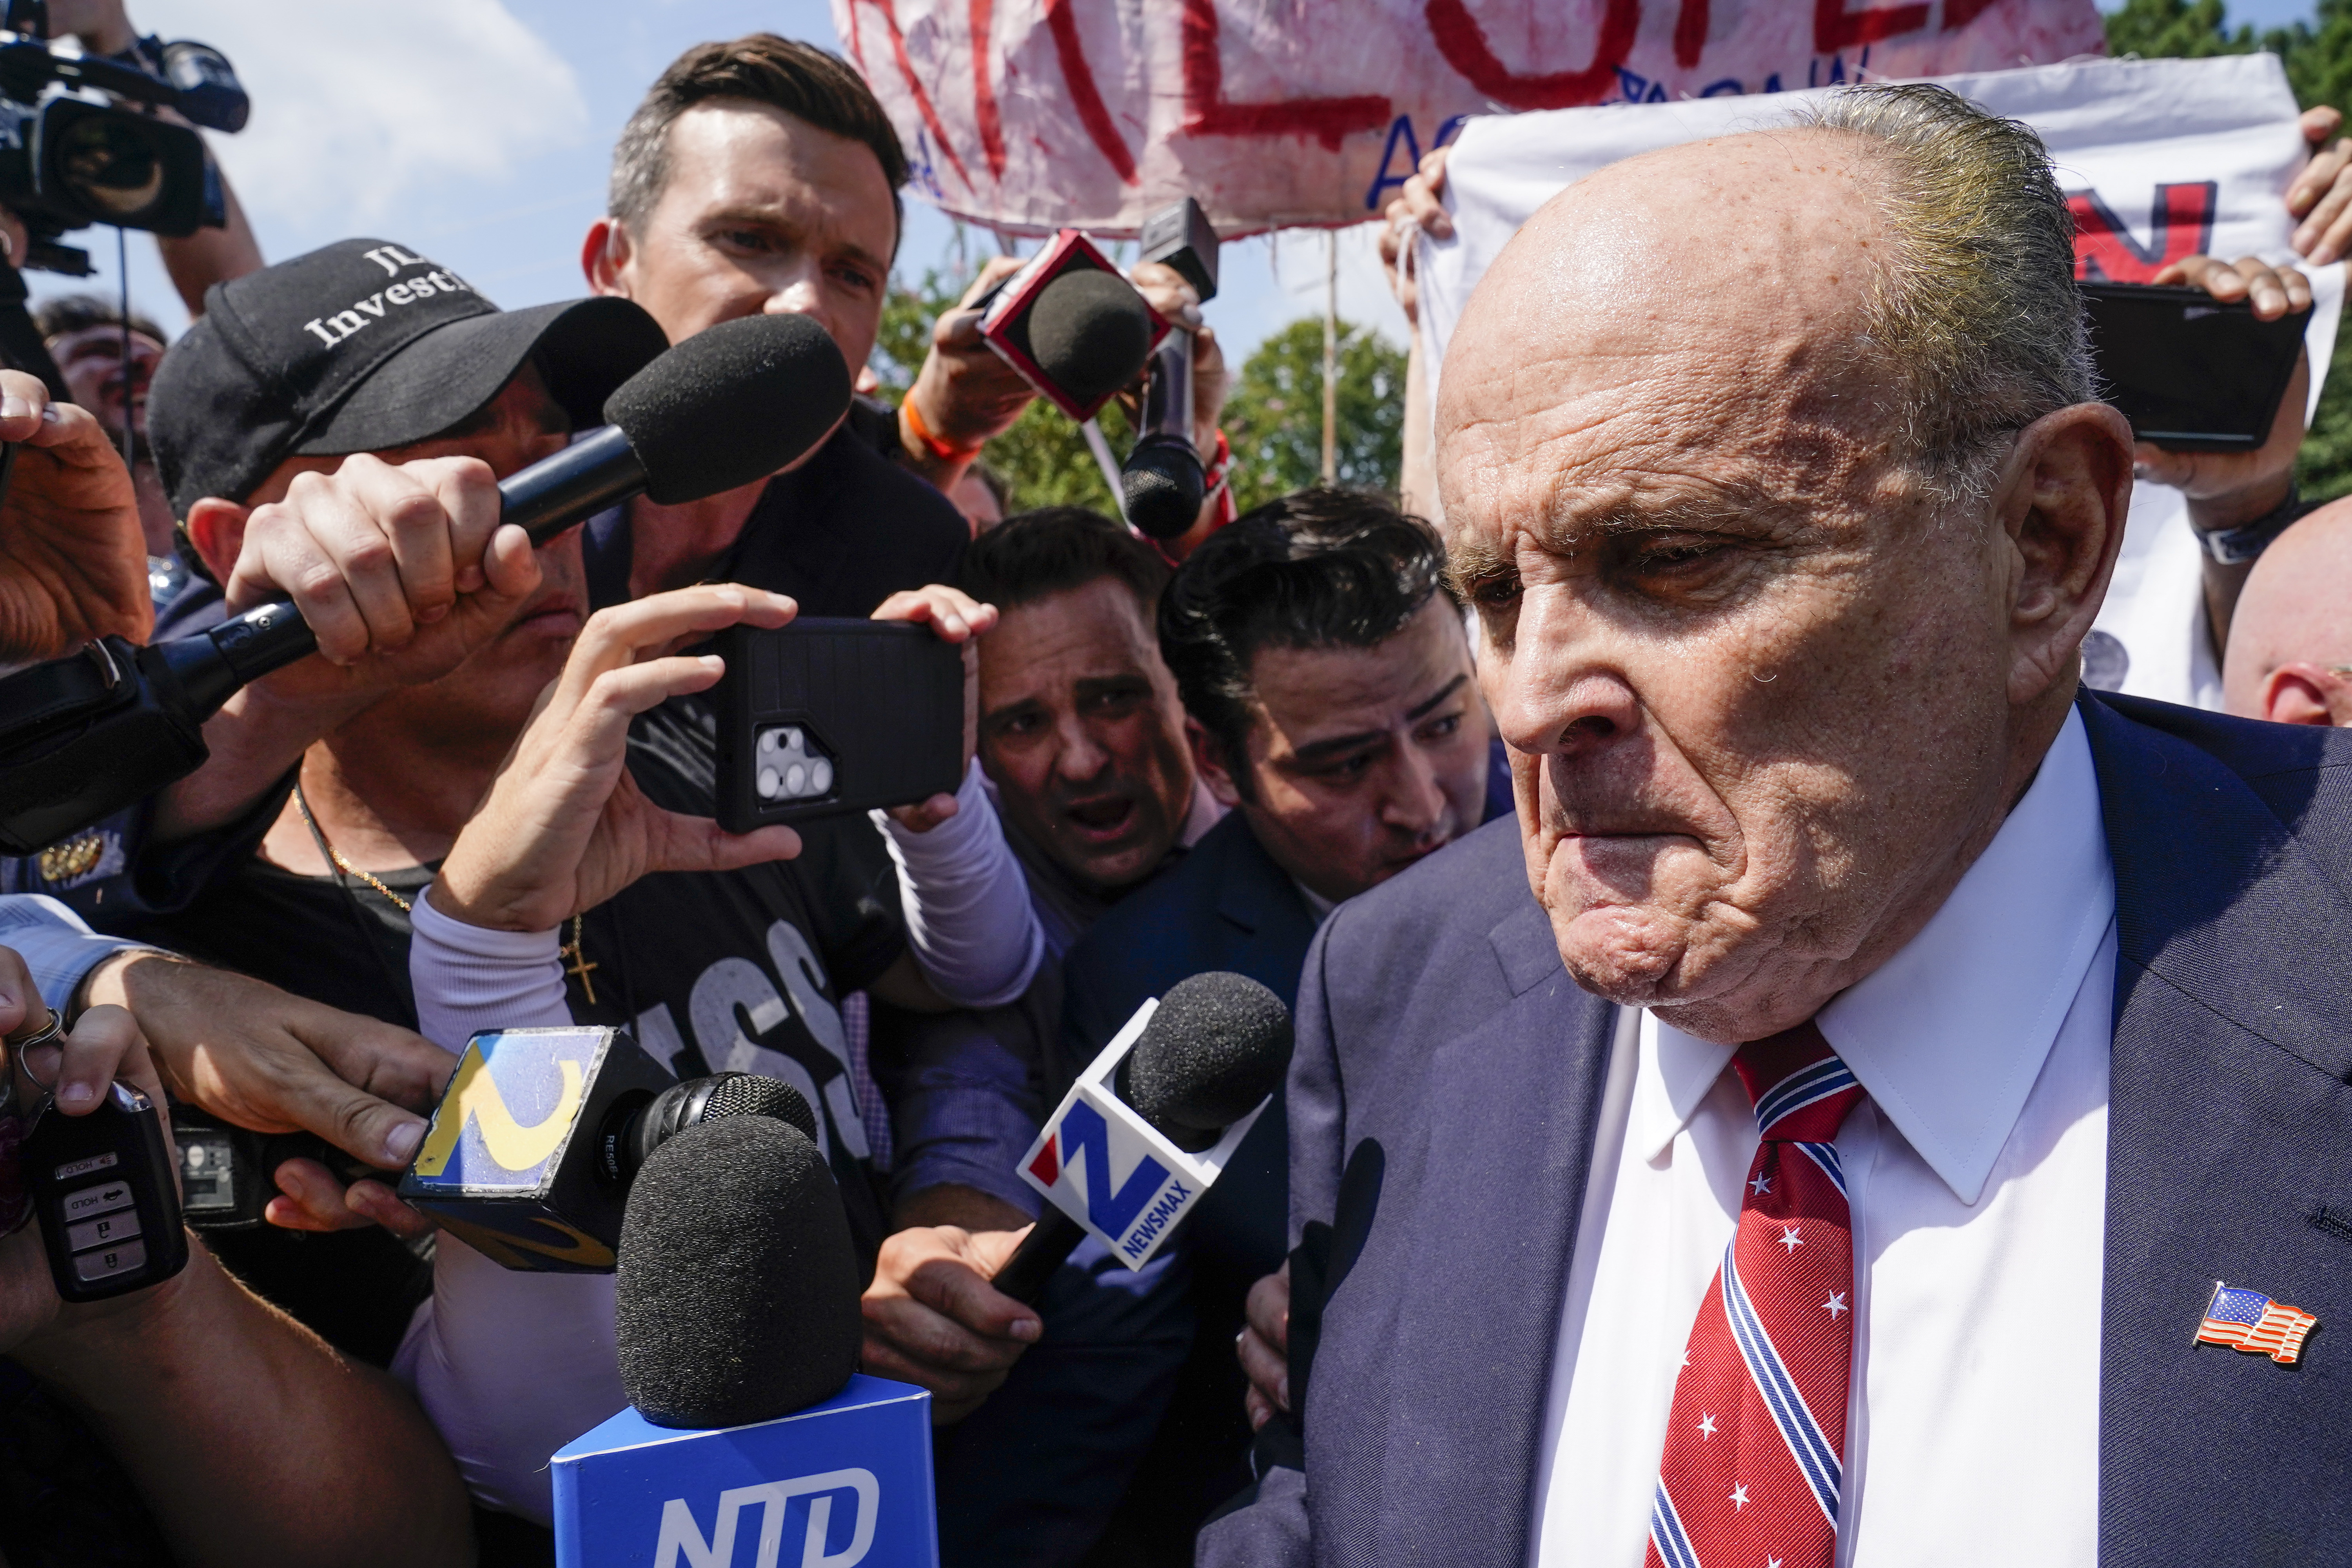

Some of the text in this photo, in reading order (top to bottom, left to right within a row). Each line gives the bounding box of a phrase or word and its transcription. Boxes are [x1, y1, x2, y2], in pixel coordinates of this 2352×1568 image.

[416, 1041, 583, 1176] 2
[66, 1161, 93, 1174] HOLD
[71, 1196, 98, 1209] HOLD
[1122, 1180, 1192, 1259] NEWSMAX
[653, 1467, 880, 1568] NTD
